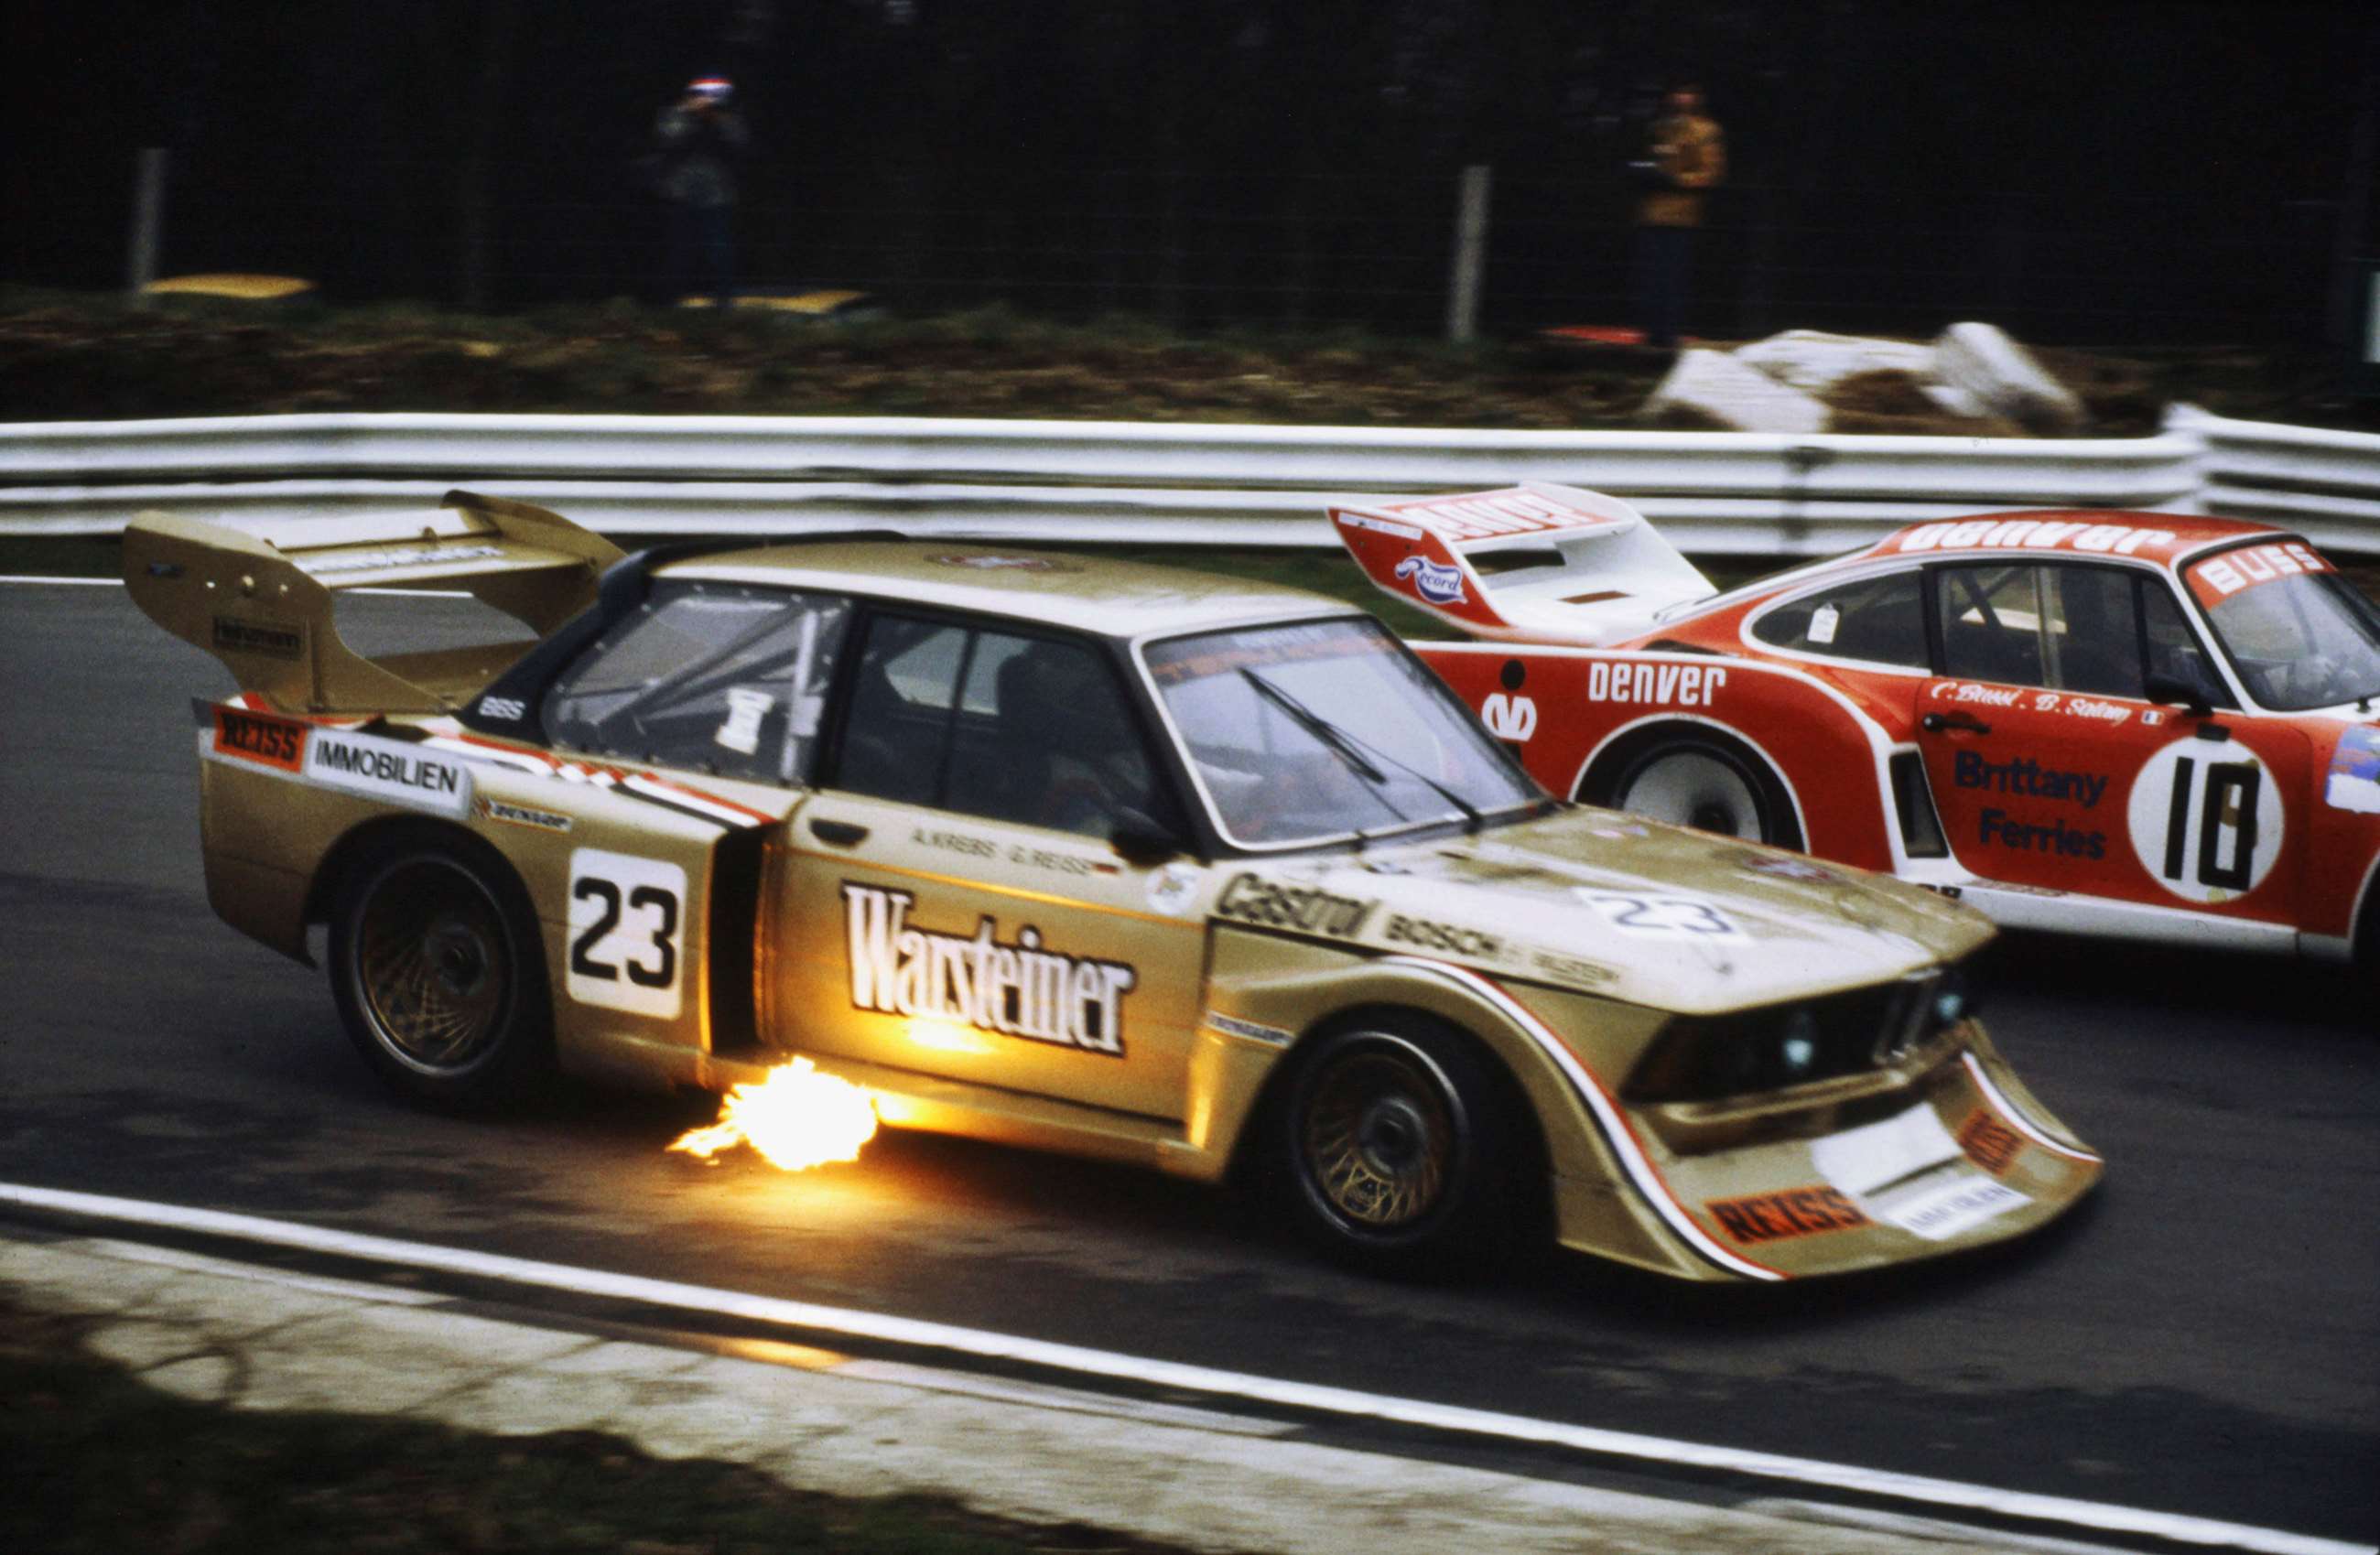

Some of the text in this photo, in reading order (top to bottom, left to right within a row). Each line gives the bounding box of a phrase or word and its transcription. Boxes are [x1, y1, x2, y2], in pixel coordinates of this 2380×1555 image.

[221, 710, 458, 794] REISS IMMOBILIEN
[1954, 750, 2109, 810] Brittany
[1980, 807, 2106, 860] Ferries
[571, 876, 677, 989] 23
[1590, 896, 1736, 934] 23
[841, 879, 1137, 1058] Warsteiner
